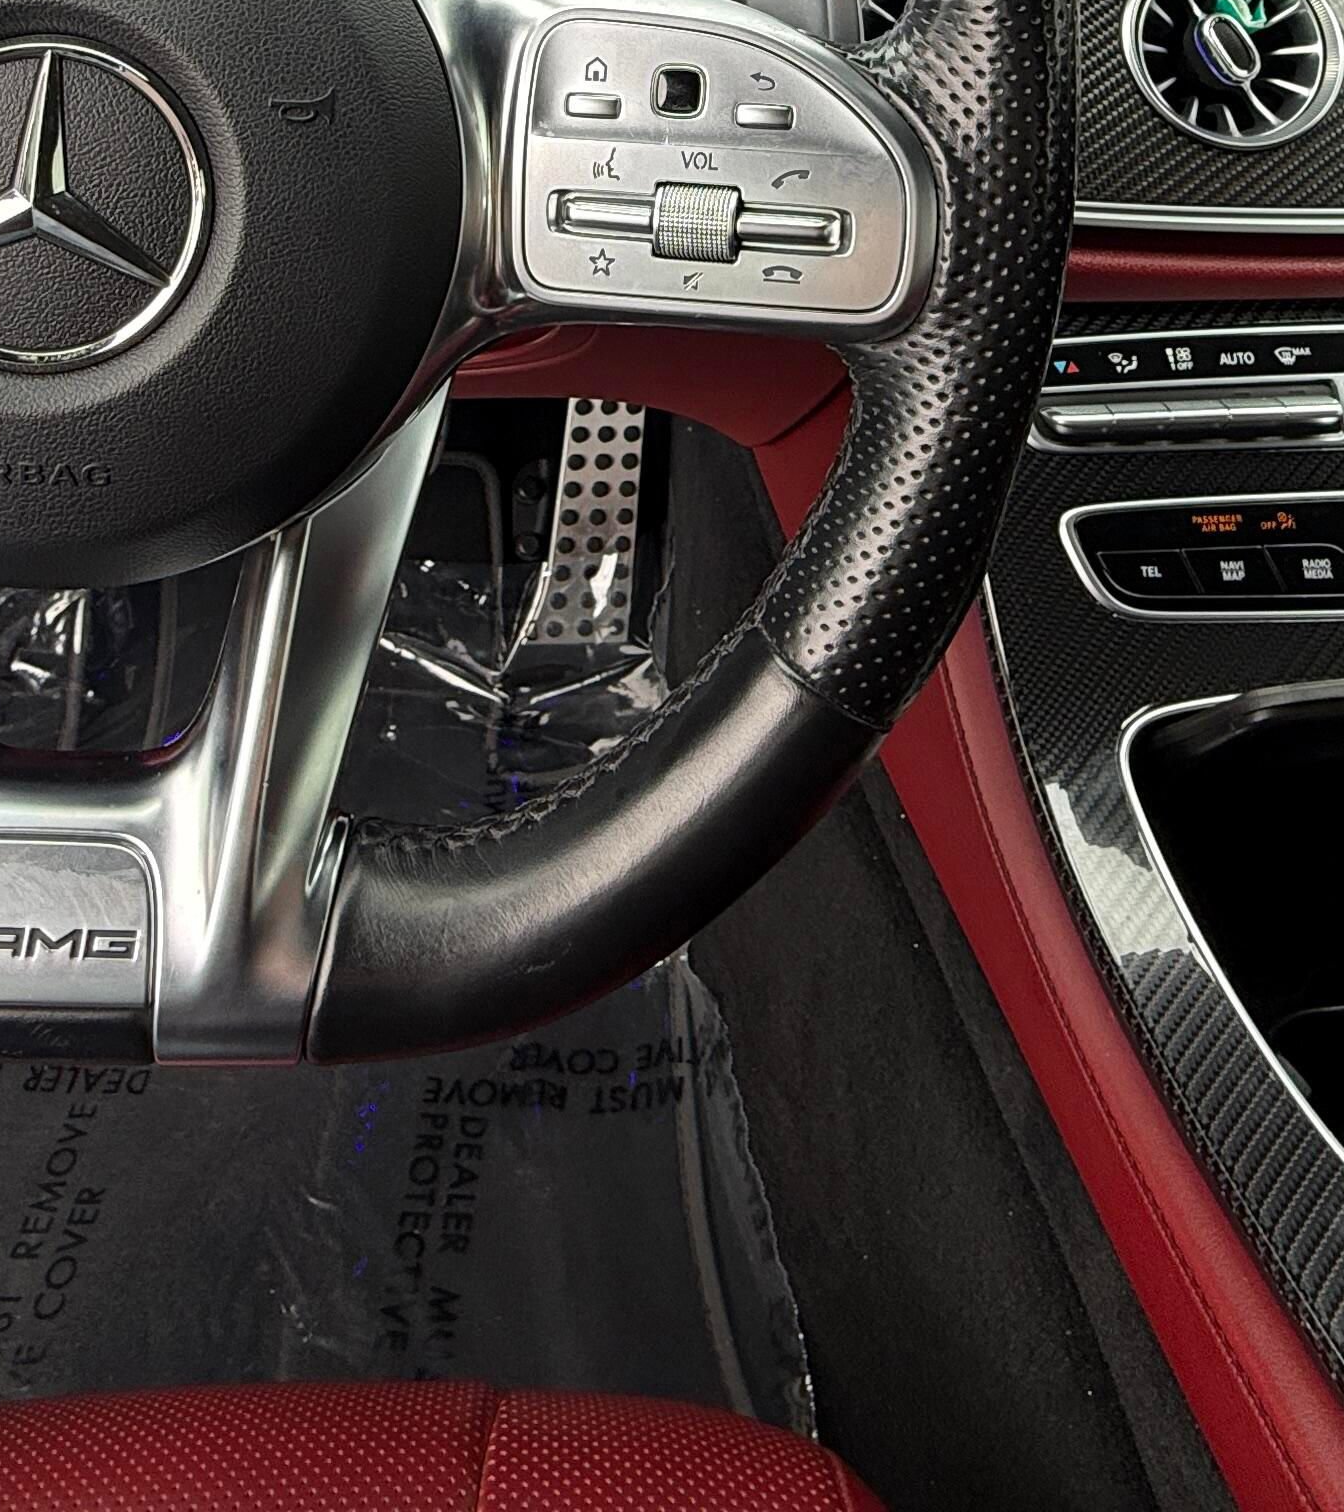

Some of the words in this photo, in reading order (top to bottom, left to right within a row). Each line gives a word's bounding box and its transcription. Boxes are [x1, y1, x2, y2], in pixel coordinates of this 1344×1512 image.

[681, 151, 719, 171] VOL
[1219, 352, 1255, 365] AUTO
[1220, 560, 1244, 570] NAVI
[1302, 558, 1331, 569] RADIO
[1140, 566, 1163, 578] TEL
[1222, 570, 1245, 581] MAP
[1304, 569, 1334, 579] MEDIA
[9, 1103, 98, 1260] REMOVE
[437, 1114, 488, 1255] DEALER
[33, 1186, 106, 1321] COVER
